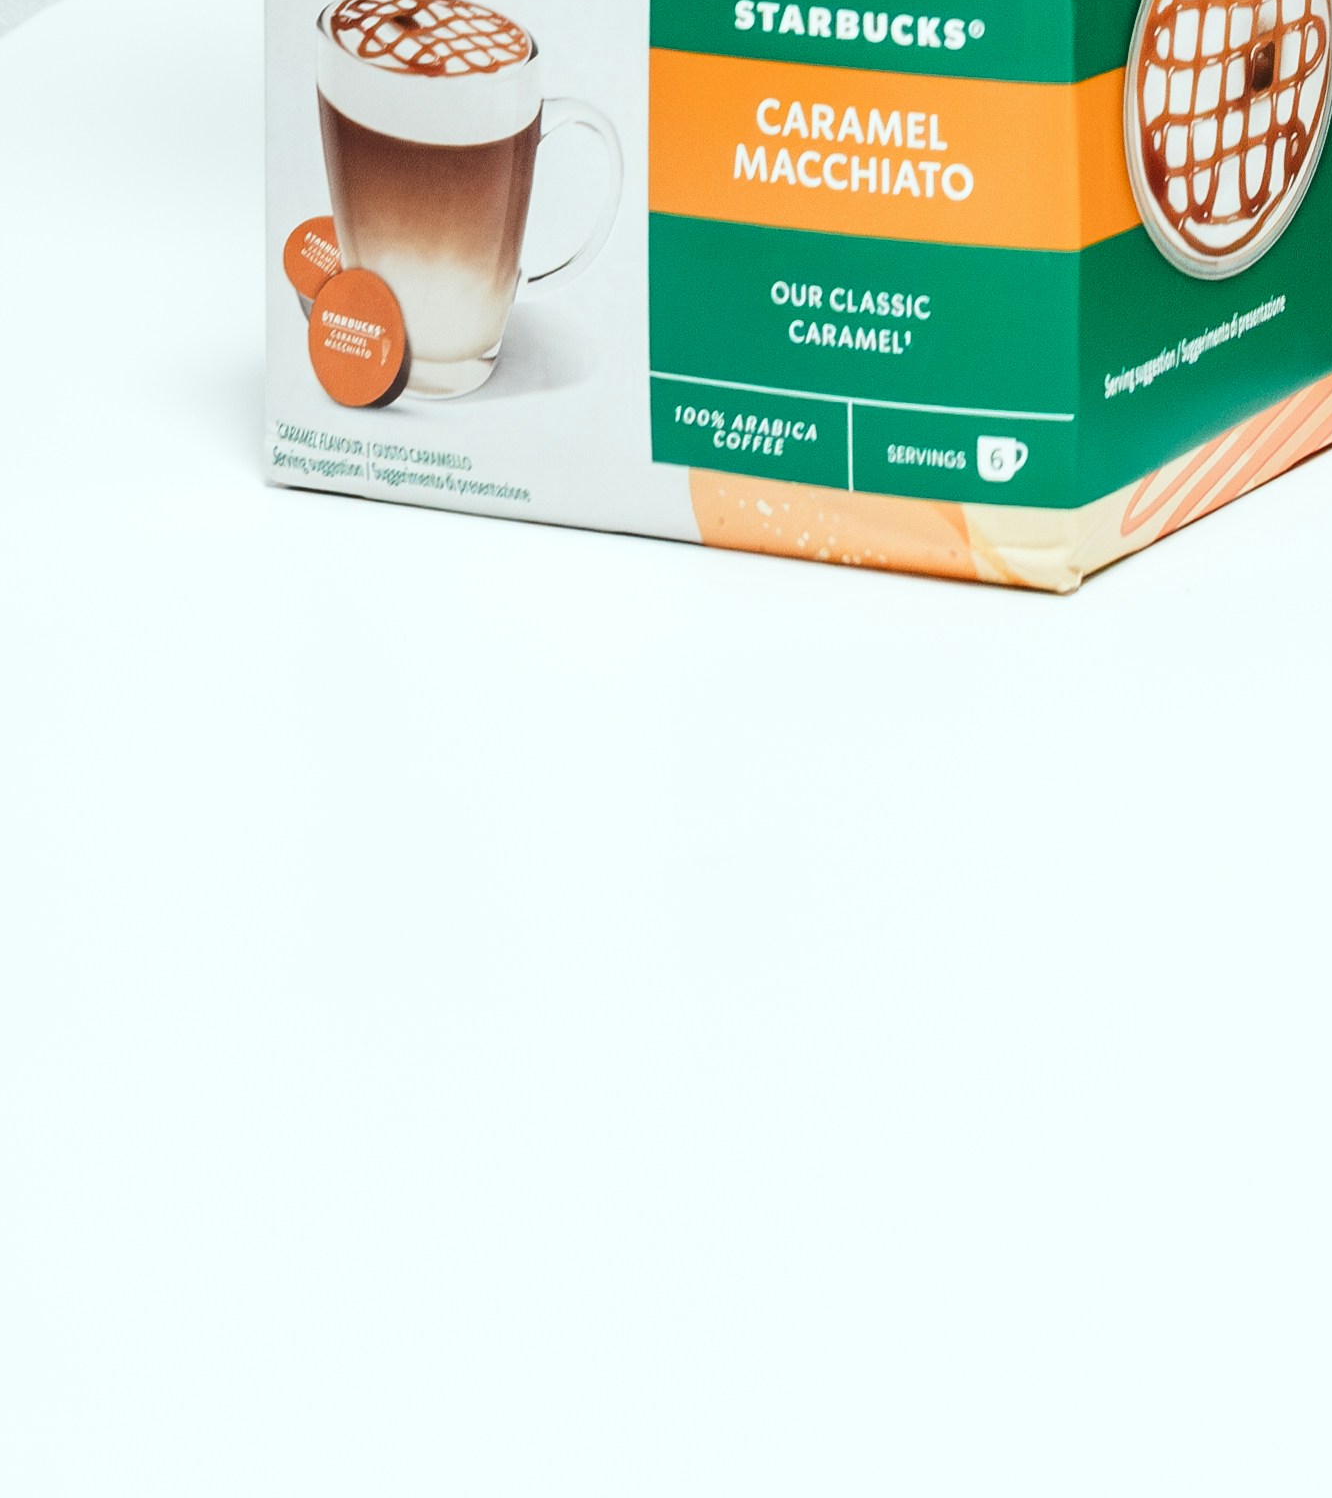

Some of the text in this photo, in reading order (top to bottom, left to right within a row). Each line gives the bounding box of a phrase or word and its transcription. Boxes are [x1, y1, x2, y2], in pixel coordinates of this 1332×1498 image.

[755, 98, 948, 151] CARAMEL
[734, 145, 974, 201] MACCHIATO
[771, 281, 930, 319] OUR CLASSIC
[675, 406, 817, 441] 100% ARABICA
[714, 431, 784, 455] COFFEE
[888, 444, 1003, 470] SERVINGS 6
